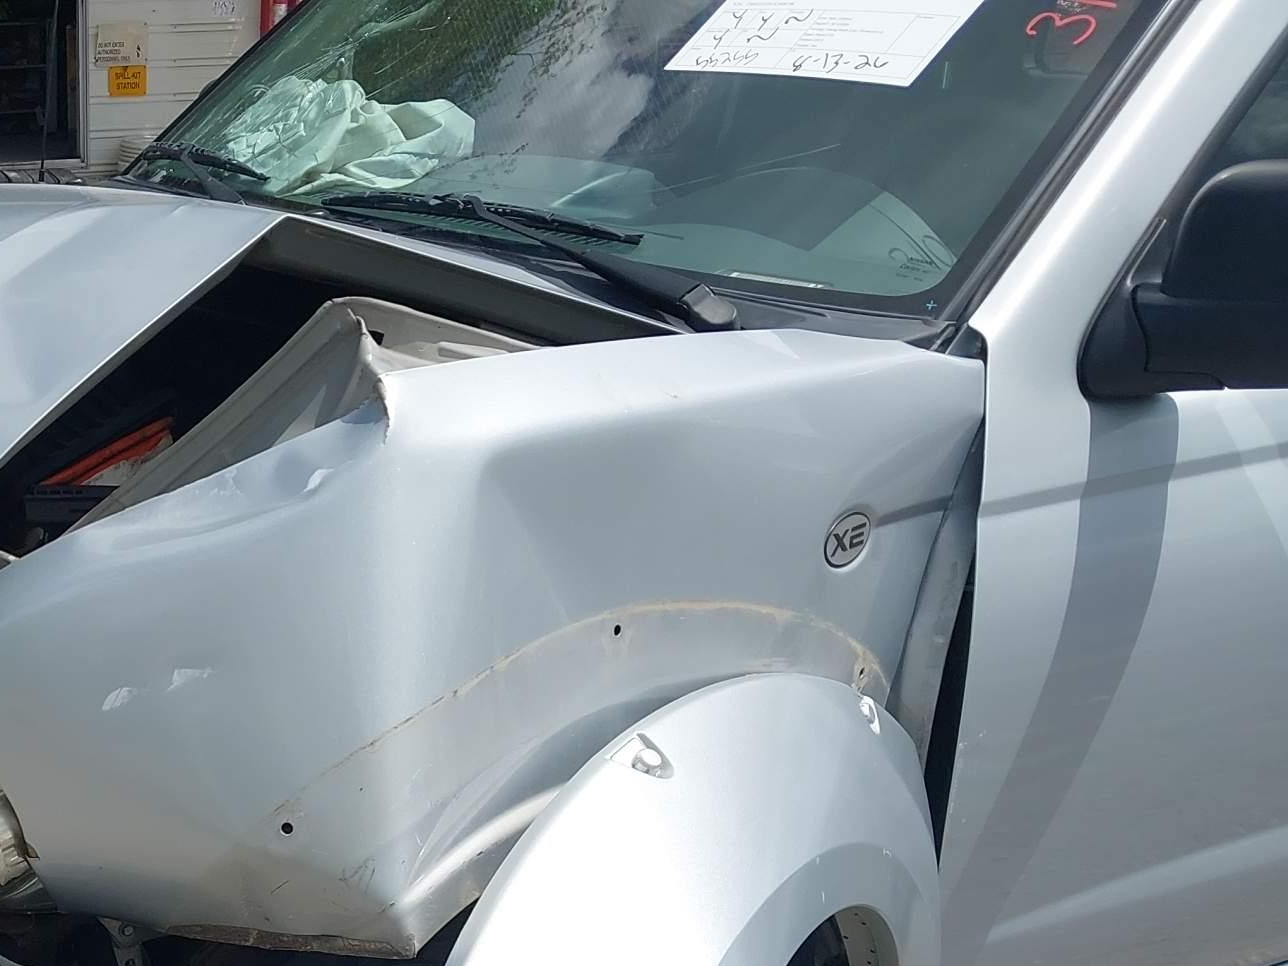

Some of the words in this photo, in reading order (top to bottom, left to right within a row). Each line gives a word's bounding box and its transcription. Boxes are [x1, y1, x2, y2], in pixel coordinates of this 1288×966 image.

[115, 71, 130, 80] SPILL
[116, 81, 140, 90] STATION
[830, 521, 867, 558] XE
